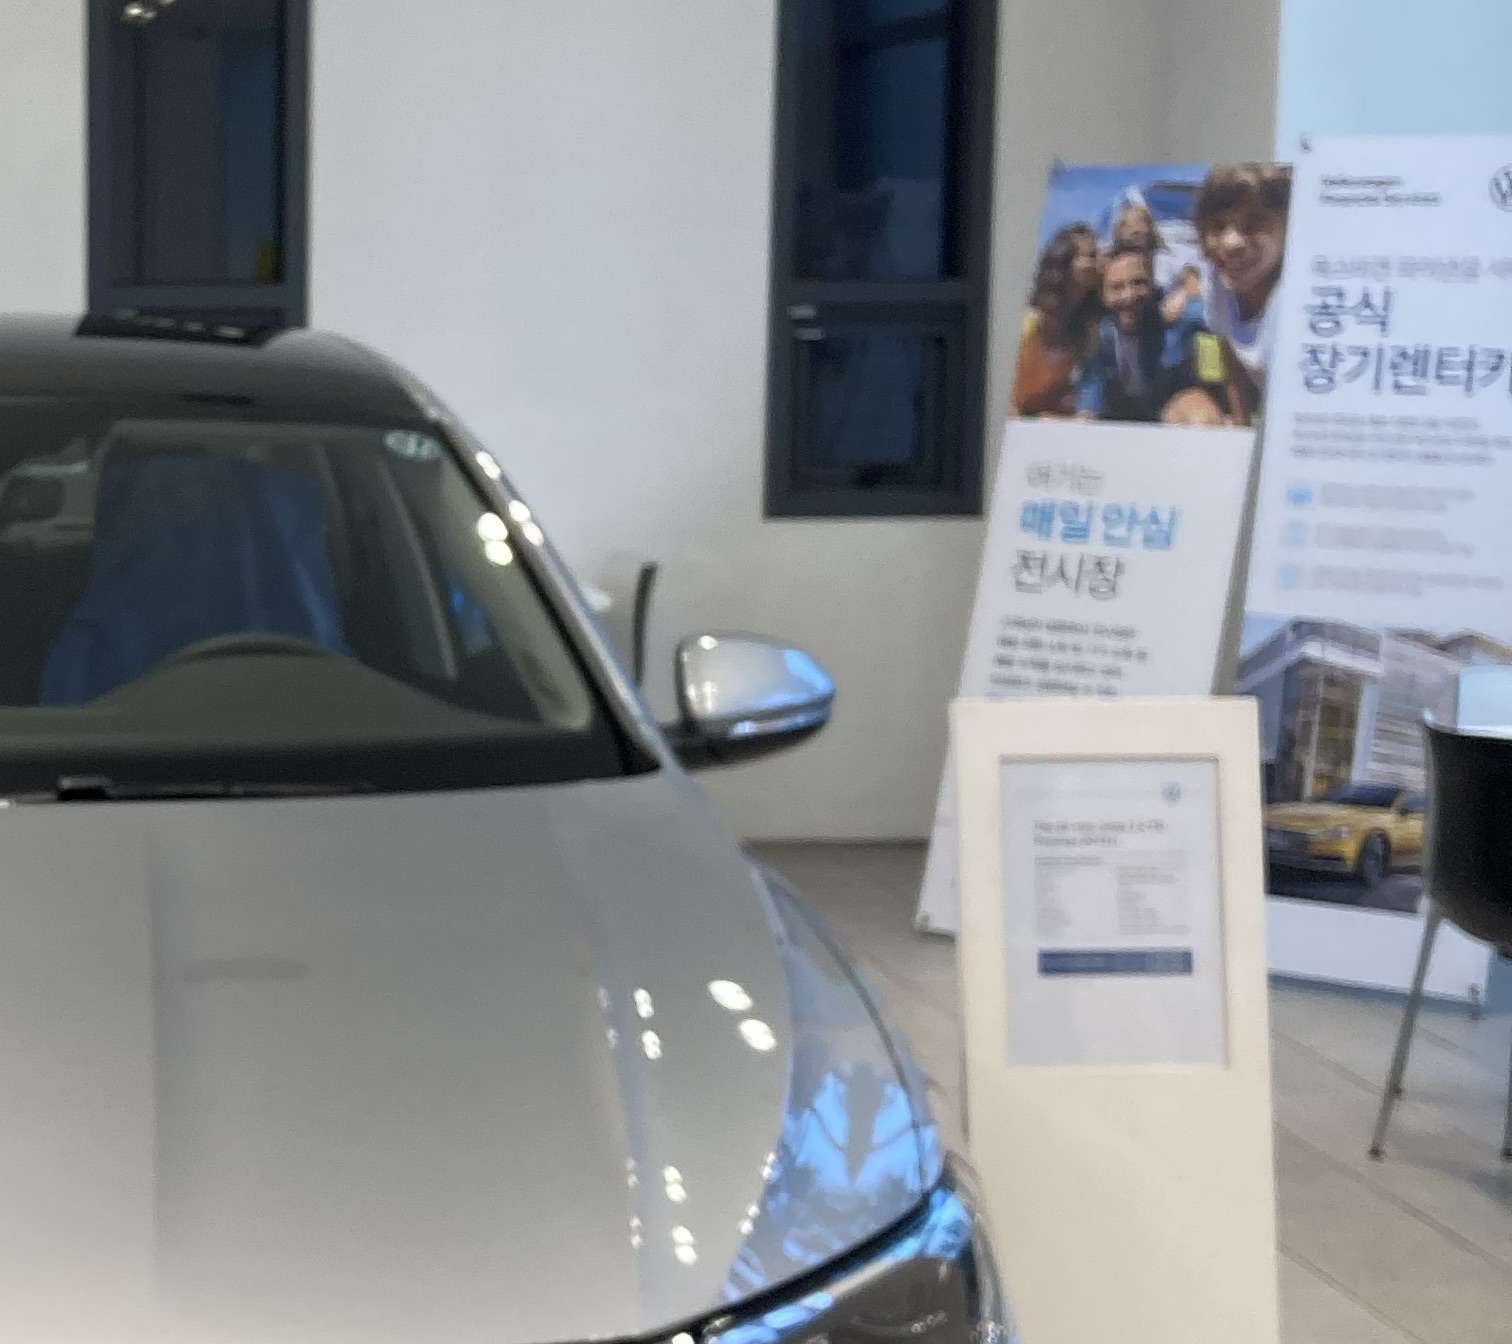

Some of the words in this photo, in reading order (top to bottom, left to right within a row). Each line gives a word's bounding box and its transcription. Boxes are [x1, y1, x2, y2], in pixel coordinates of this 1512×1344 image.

[1304, 286, 1396, 338] 공식
[1020, 500, 1094, 544] 매일
[1101, 503, 1178, 550] 안심
[1012, 550, 1125, 600] 전시장
